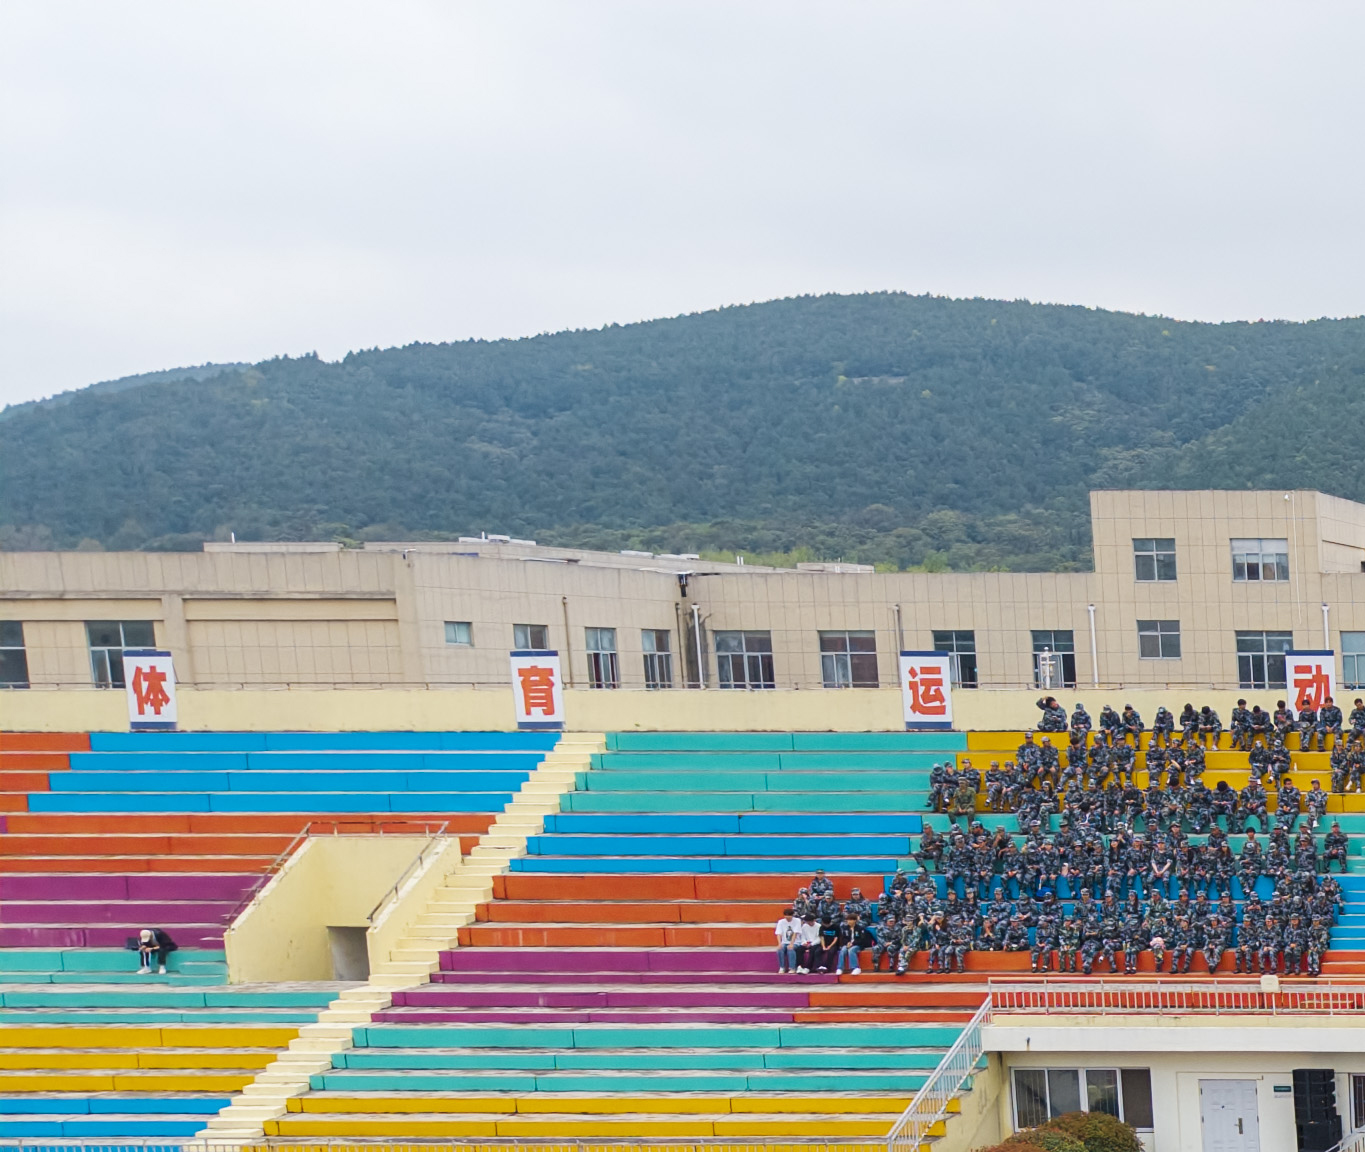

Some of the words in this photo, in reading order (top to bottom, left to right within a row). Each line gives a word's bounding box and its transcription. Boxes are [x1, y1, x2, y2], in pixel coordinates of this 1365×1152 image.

[133, 665, 170, 715] 体
[518, 666, 555, 716] 育
[909, 666, 946, 716] 运
[1293, 664, 1331, 712] 动
